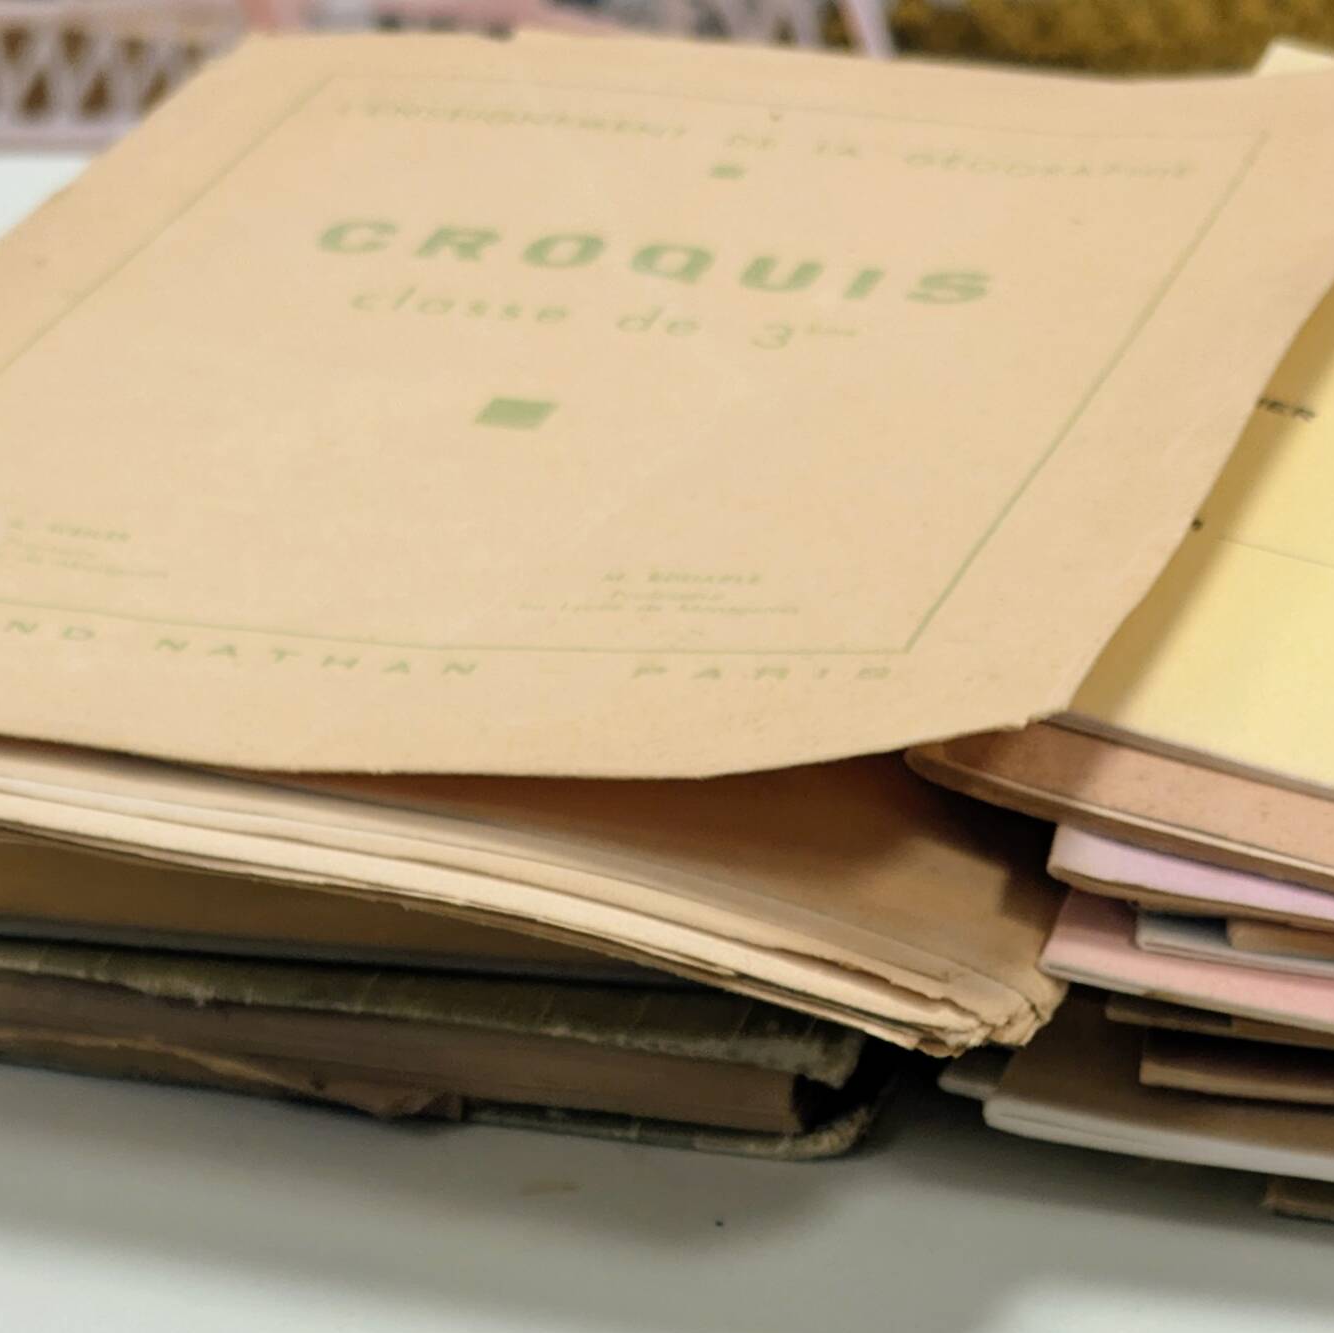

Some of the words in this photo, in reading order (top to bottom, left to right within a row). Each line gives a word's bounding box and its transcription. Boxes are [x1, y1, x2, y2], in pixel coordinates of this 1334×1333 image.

[316, 216, 995, 305] CROQUIS
[349, 284, 571, 325] classe
[614, 303, 703, 338] de
[155, 636, 479, 677] NATHAN
[630, 664, 892, 681] PARIS
